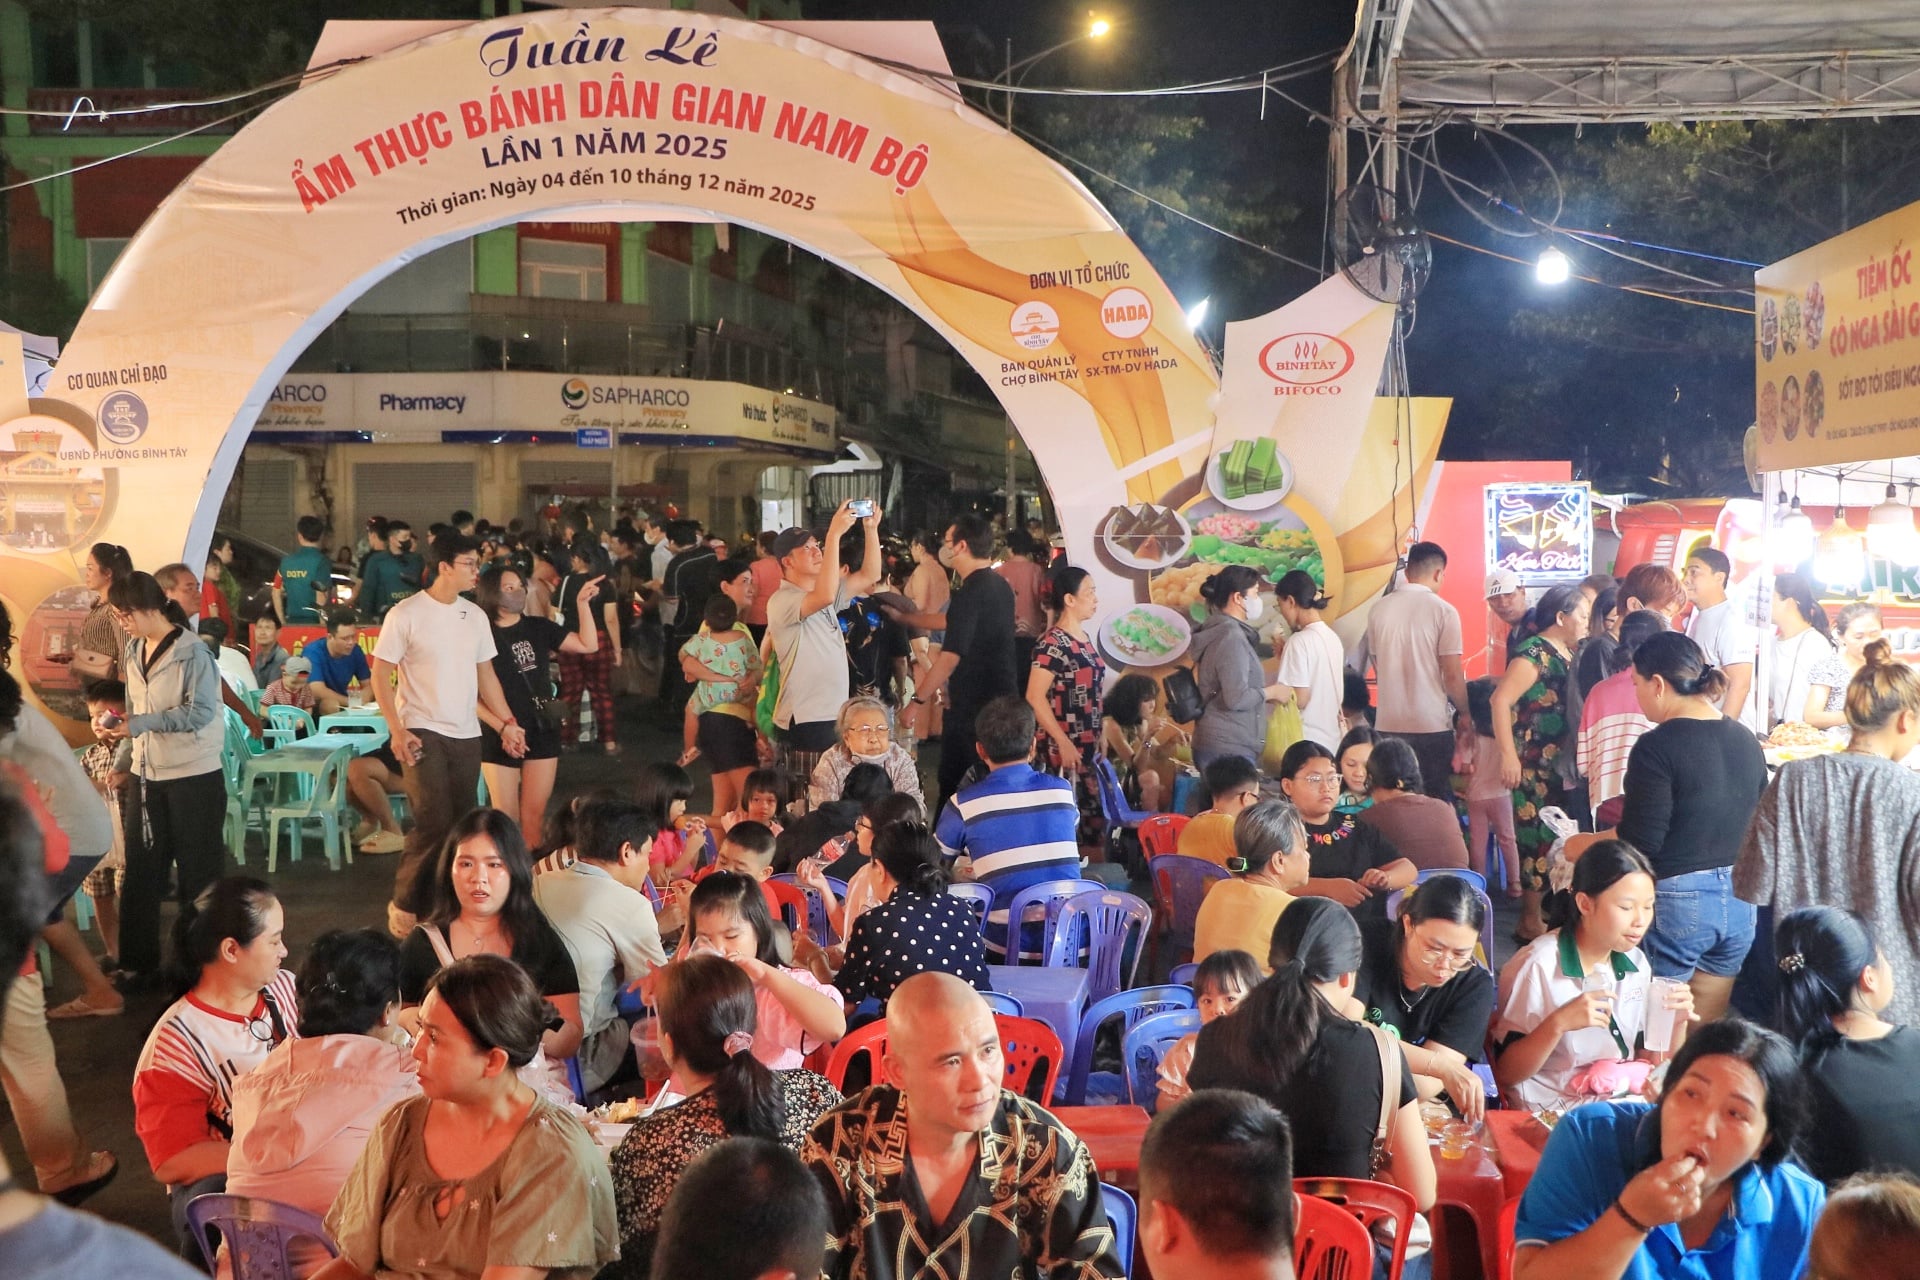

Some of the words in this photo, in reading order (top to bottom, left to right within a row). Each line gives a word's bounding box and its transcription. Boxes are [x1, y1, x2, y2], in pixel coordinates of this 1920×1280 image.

[480, 22, 629, 77] Tuần
[291, 158, 357, 214] ẨM
[353, 110, 453, 177] THỰC
[460, 86, 567, 140] BÁNH
[579, 72, 660, 120] DÂN
[671, 82, 767, 133] GIAN
[773, 101, 869, 164] NAM
[870, 136, 929, 196] BỘ
[481, 135, 542, 169] LẦN
[551, 136, 563, 157] 1
[576, 128, 646, 156] NĂM
[654, 133, 728, 160] 2025
[397, 198, 438, 226] Thời
[441, 188, 487, 215] gian:
[490, 177, 537, 200] Ngày
[541, 172, 564, 190] 04
[569, 168, 604, 187] đến
[609, 168, 632, 184] 10
[636, 168, 692, 191] tháng
[698, 173, 720, 191] 12
[724, 178, 765, 200] năm
[768, 185, 817, 212] 2025
[1891, 238, 1911, 288] ỐC
[1030, 272, 1057, 290] ĐƠN
[1060, 270, 1073, 289] VỊ
[1075, 261, 1092, 284] TỔ
[1095, 262, 1130, 282] CHỨC
[1104, 304, 1148, 324] HADA
[1001, 361, 1025, 373] BAN
[1028, 356, 1062, 370] QUẢN
[1064, 355, 1077, 366] LÝ
[1102, 350, 1124, 362] CTY
[1126, 347, 1159, 359] TNHH
[67, 372, 84, 391] CƠ
[86, 370, 119, 389] QUAN
[120, 363, 141, 384] CHỈ
[142, 364, 168, 385] ĐẠO
[1001, 374, 1026, 388] CHỢ
[1029, 370, 1057, 383] BÌNH
[1059, 368, 1079, 380] TÂY
[1086, 361, 1141, 378] SX-TM-DV
[1144, 358, 1178, 371] HADA
[592, 386, 690, 407] SAPHARCO
[1274, 386, 1341, 395] BIFOCO
[380, 393, 466, 414] Pharmacy
[642, 407, 688, 419] Pharmacy
[60, 449, 91, 461] UBND
[92, 448, 140, 460] PHƯỜNG
[142, 448, 168, 459] BÌNH
[169, 447, 188, 458] TÂY
[286, 570, 308, 578] DQTV
